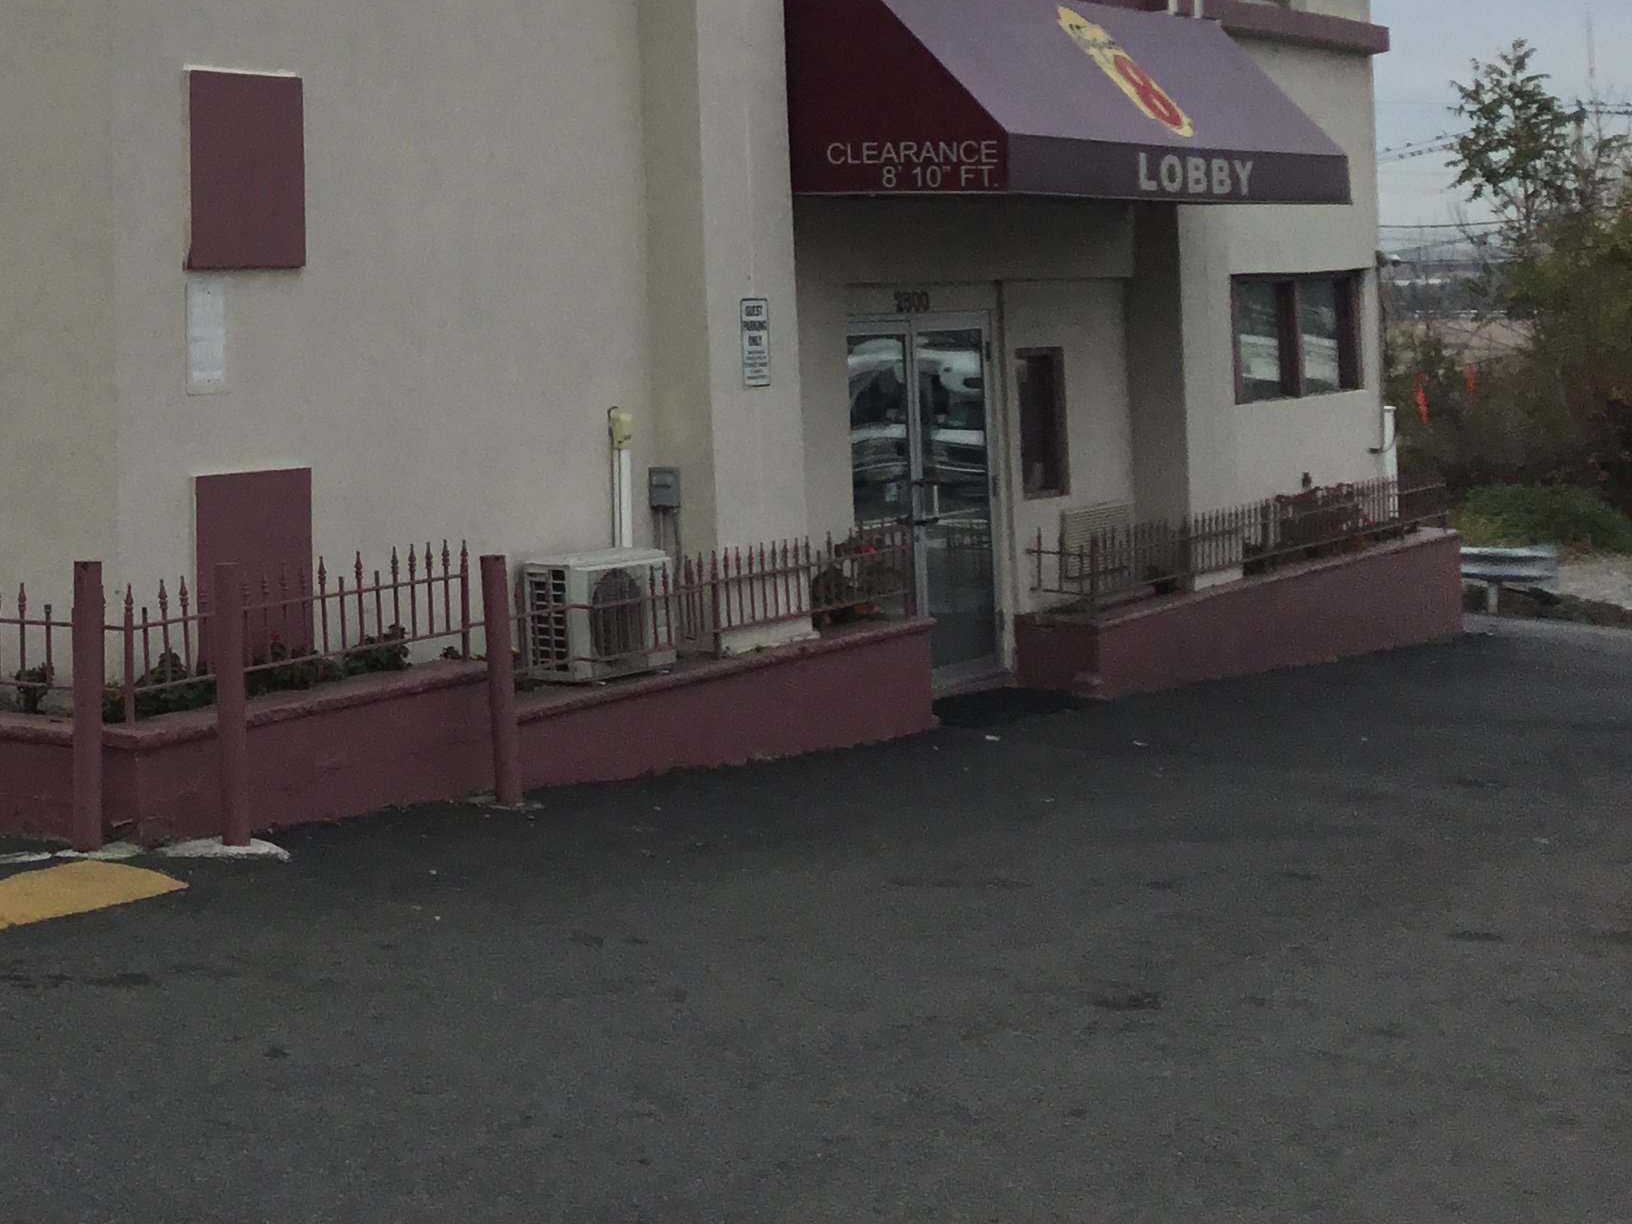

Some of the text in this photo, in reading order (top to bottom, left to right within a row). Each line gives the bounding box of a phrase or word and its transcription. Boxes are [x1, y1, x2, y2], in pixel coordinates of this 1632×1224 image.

[1113, 54, 1184, 130] 8
[826, 140, 999, 165] CLEARANCE
[882, 165, 903, 188] 8'
[960, 165, 999, 188] FT.
[1137, 151, 1255, 196] LOBBY
